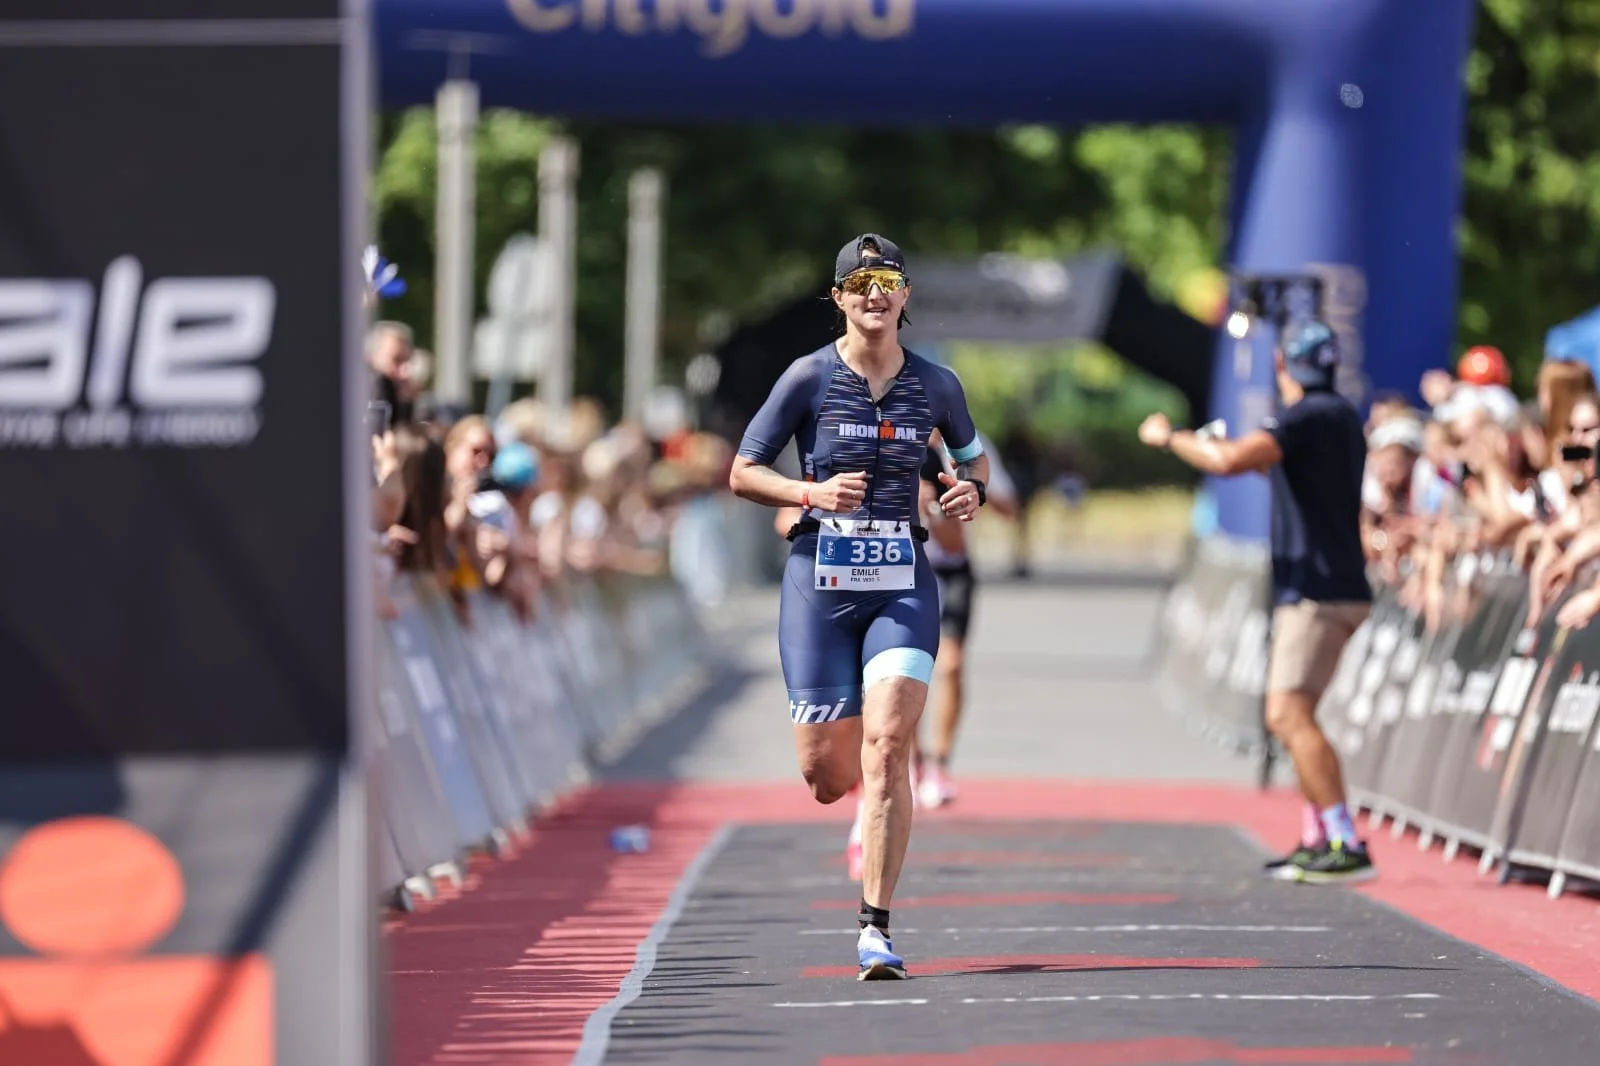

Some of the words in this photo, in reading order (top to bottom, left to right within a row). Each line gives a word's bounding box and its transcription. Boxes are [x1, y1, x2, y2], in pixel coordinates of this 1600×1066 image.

[838, 421, 917, 441] IRONMAN
[850, 540, 902, 563] 336
[851, 568, 880, 576] EMILIE
